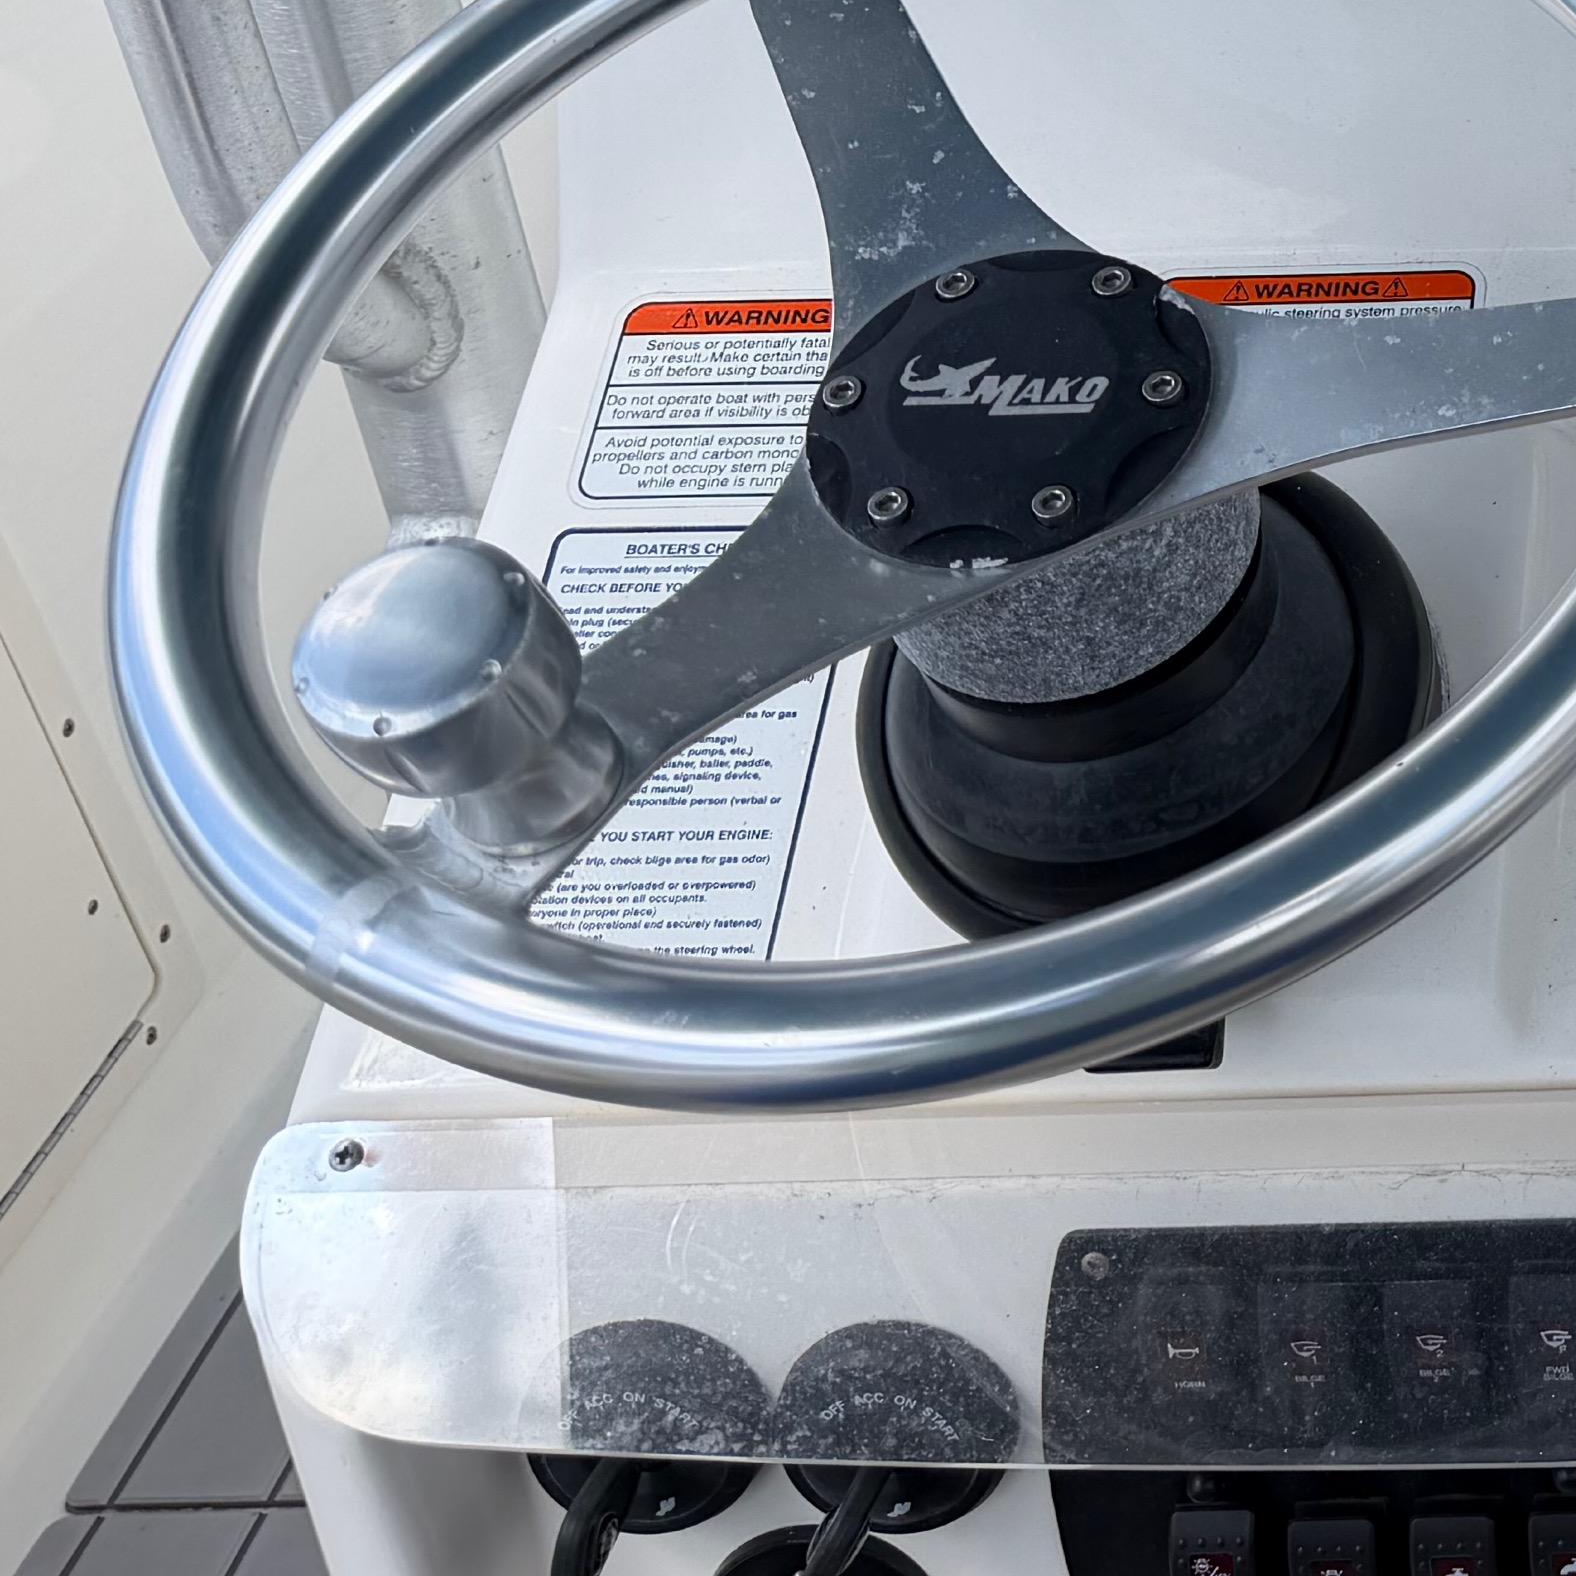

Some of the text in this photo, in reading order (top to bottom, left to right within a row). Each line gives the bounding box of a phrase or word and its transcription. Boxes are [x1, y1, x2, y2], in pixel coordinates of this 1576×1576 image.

[1254, 280, 1380, 298] WARNING
[704, 308, 831, 326] WARNING
[647, 338, 796, 353] Serious potentially
[710, 351, 801, 363] Make certain
[644, 364, 825, 378] off before using boarding
[716, 392, 781, 405] boat with
[972, 373, 1110, 415] MAKO
[605, 435, 785, 449] Avoid potential exposure
[625, 543, 700, 555] BOATER'S
[561, 583, 661, 594] CHECK BEFORE
[600, 829, 773, 842] YOU START YOUR ENGINE:
[854, 1392, 885, 1405] ACC
